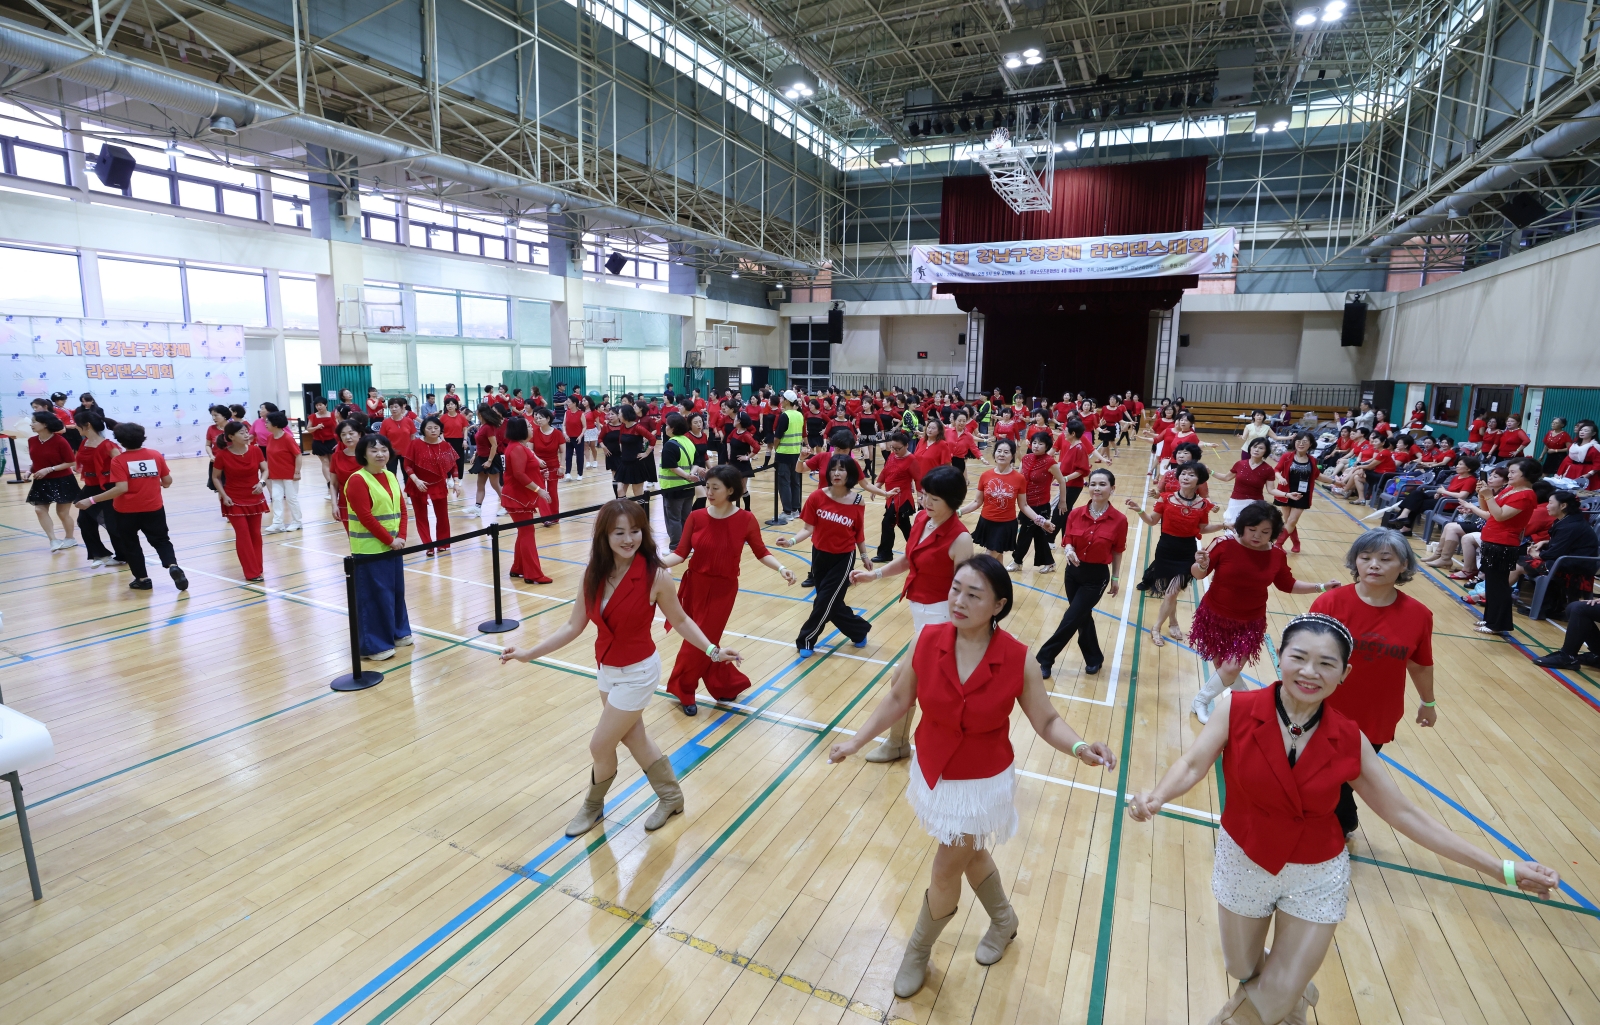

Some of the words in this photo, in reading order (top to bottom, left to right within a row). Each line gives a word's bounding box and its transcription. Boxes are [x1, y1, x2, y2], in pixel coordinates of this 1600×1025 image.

[926, 250, 970, 265] 제1회
[976, 245, 1081, 263] 강남구청장배
[1091, 237, 1208, 259] 라인댄스대회
[56, 339, 101, 357] 제1회
[105, 340, 192, 358] 강남구청장배
[85, 363, 175, 380] 라인댄스대회
[138, 462, 147, 472] 8
[816, 509, 854, 528] COMMON
[1353, 638, 1408, 660] RECTION
